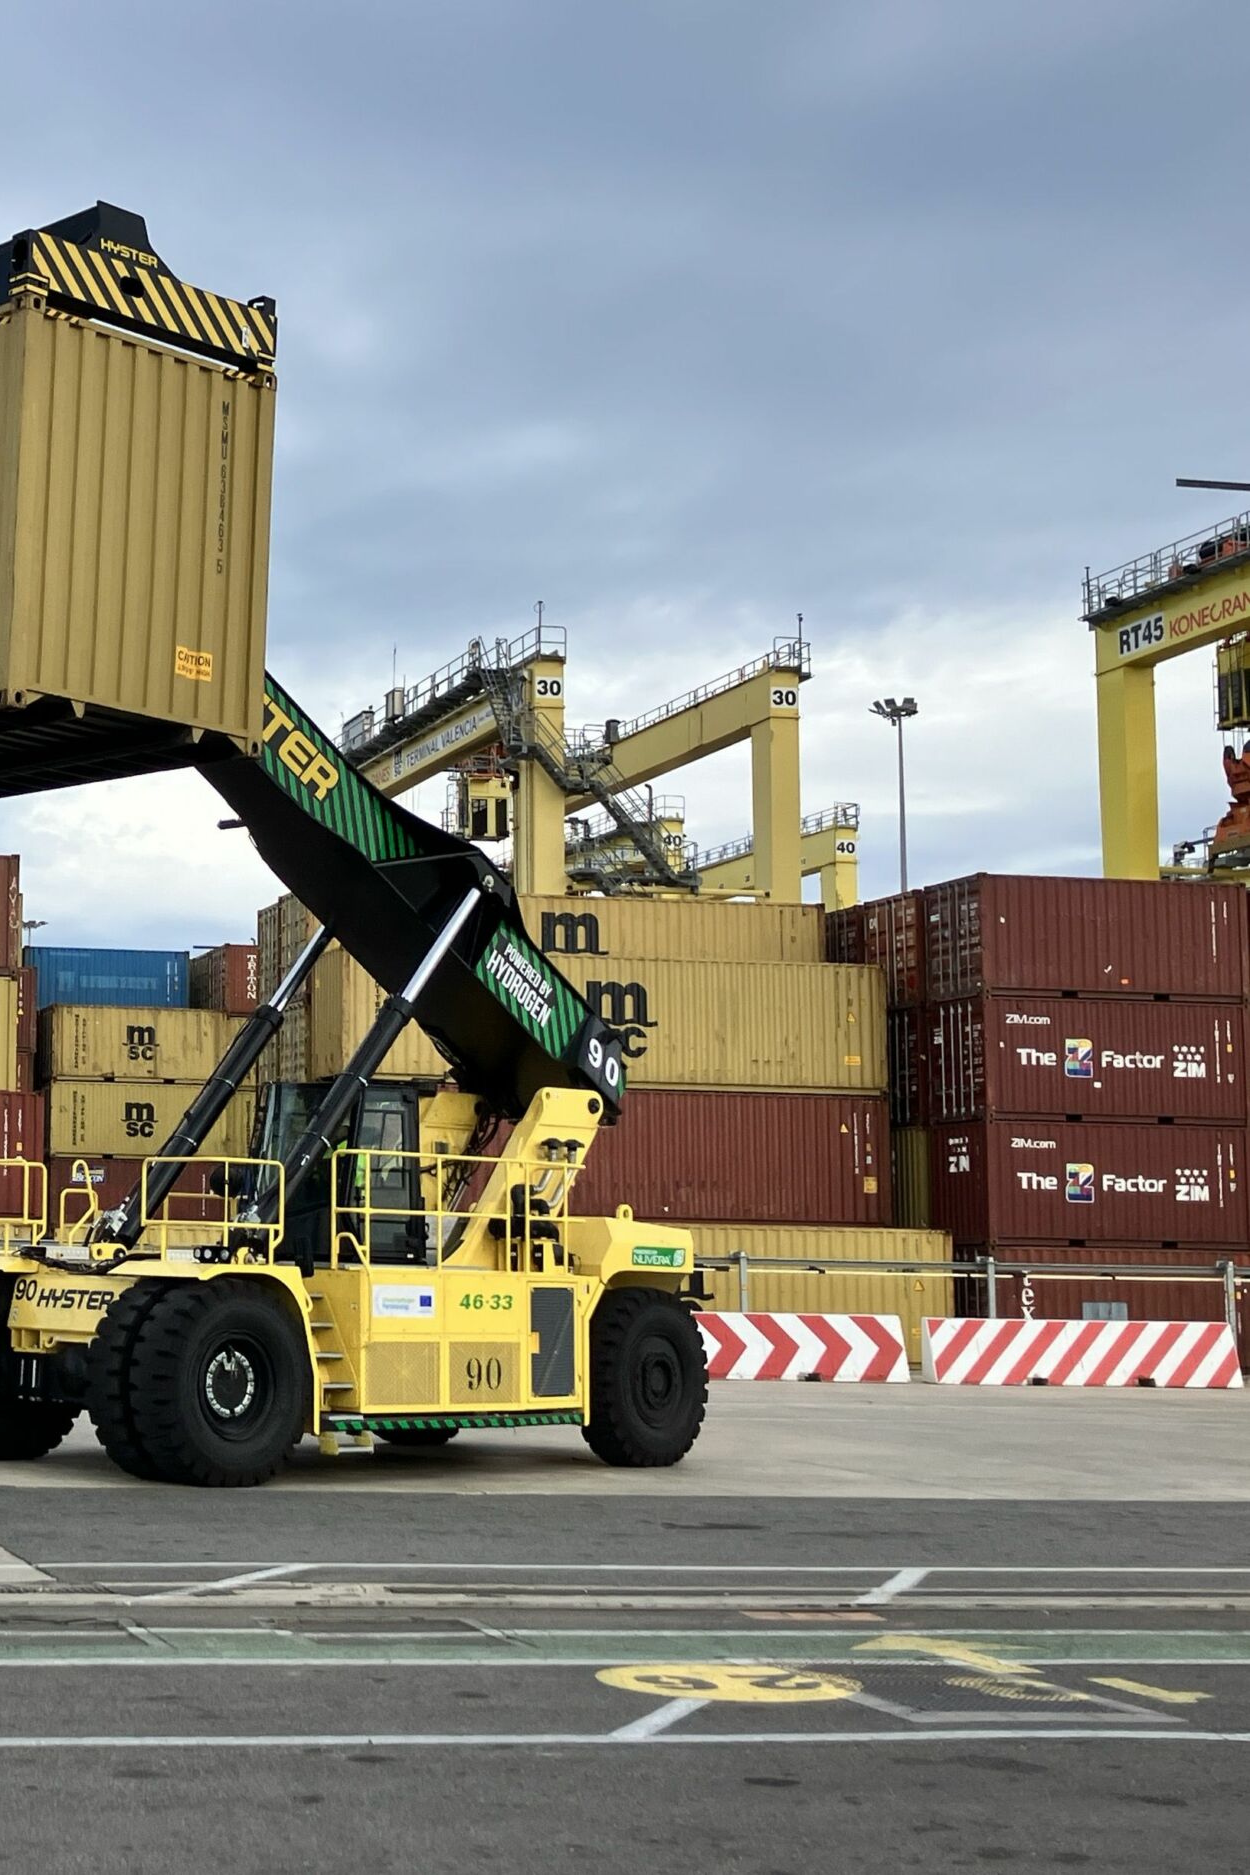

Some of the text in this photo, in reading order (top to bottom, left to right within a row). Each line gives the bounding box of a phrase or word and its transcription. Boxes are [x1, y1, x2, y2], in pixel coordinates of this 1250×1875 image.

[100, 237, 158, 269] HYSTER
[221, 400, 230, 460] MSMU
[1119, 615, 1165, 655] RT45
[536, 679, 562, 696] 30
[772, 689, 797, 706] 30
[263, 693, 339, 801] TER
[406, 715, 478, 768] TERMINAL VALENCIA
[663, 834, 682, 847] 40
[836, 841, 856, 854] 40
[246, 954, 257, 1000] TRITON
[503, 943, 553, 999] POWERED BY
[486, 949, 552, 1028] HYDROGEN
[1005, 1013, 1051, 1025] ZIM.com
[587, 1037, 619, 1087] 90
[1016, 1047, 1057, 1066] The
[1101, 1051, 1165, 1069] Factor
[1173, 1061, 1206, 1078] ZIM
[1011, 1137, 1056, 1149] ZIM.com
[1017, 1172, 1058, 1190] The
[1102, 1174, 1167, 1193] Factor
[1175, 1184, 1210, 1202] ZIM
[633, 1254, 671, 1266] NUVERA
[15, 1278, 115, 1311] 90 HYSTER
[466, 1357, 502, 1391] 90
